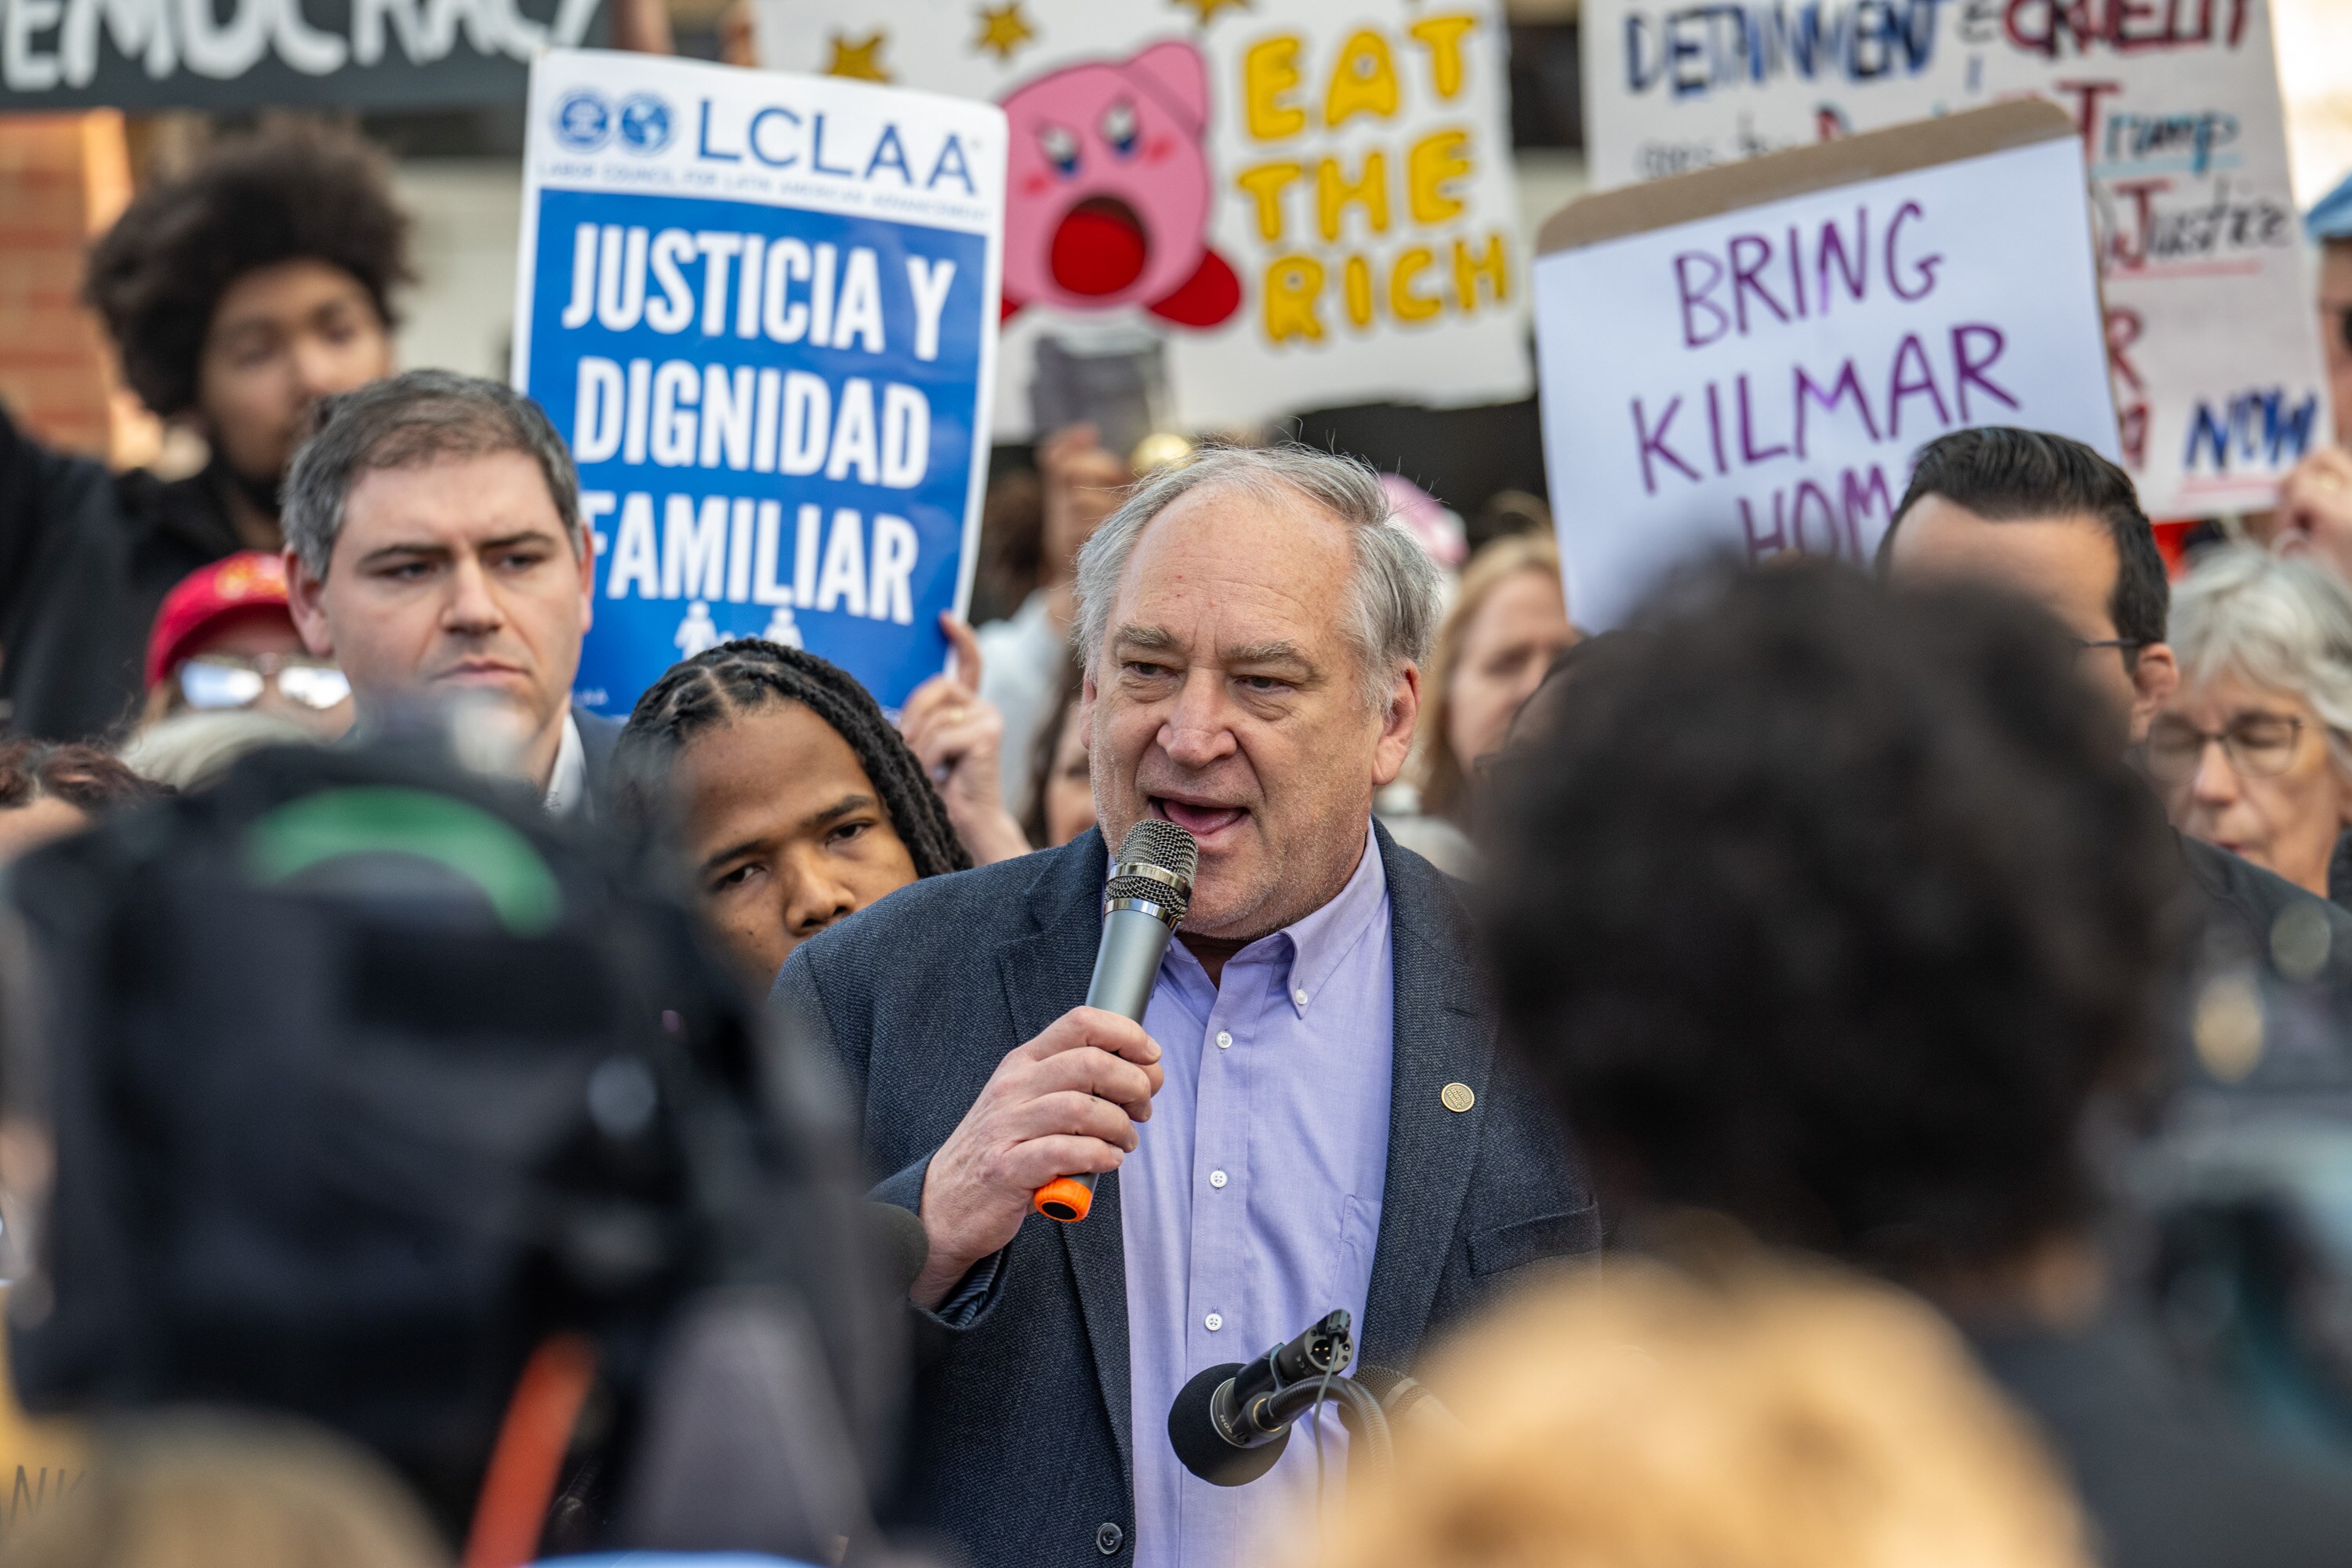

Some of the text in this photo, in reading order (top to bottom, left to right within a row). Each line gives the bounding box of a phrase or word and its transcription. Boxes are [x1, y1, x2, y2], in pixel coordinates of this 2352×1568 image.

[1245, 14, 1479, 143] EAT
[698, 96, 978, 196] LCLAA
[1237, 129, 1472, 245] THE
[561, 223, 959, 363] JUSTICIA Y
[1262, 235, 1508, 345] RICH
[1671, 198, 1944, 350] BRING
[572, 354, 933, 491] DIGNIDAD
[1631, 323, 2023, 497] KILMAR
[2183, 386, 2319, 474] NOW
[577, 489, 920, 627] FAMILIAR
[1735, 461, 1919, 568] HOM
